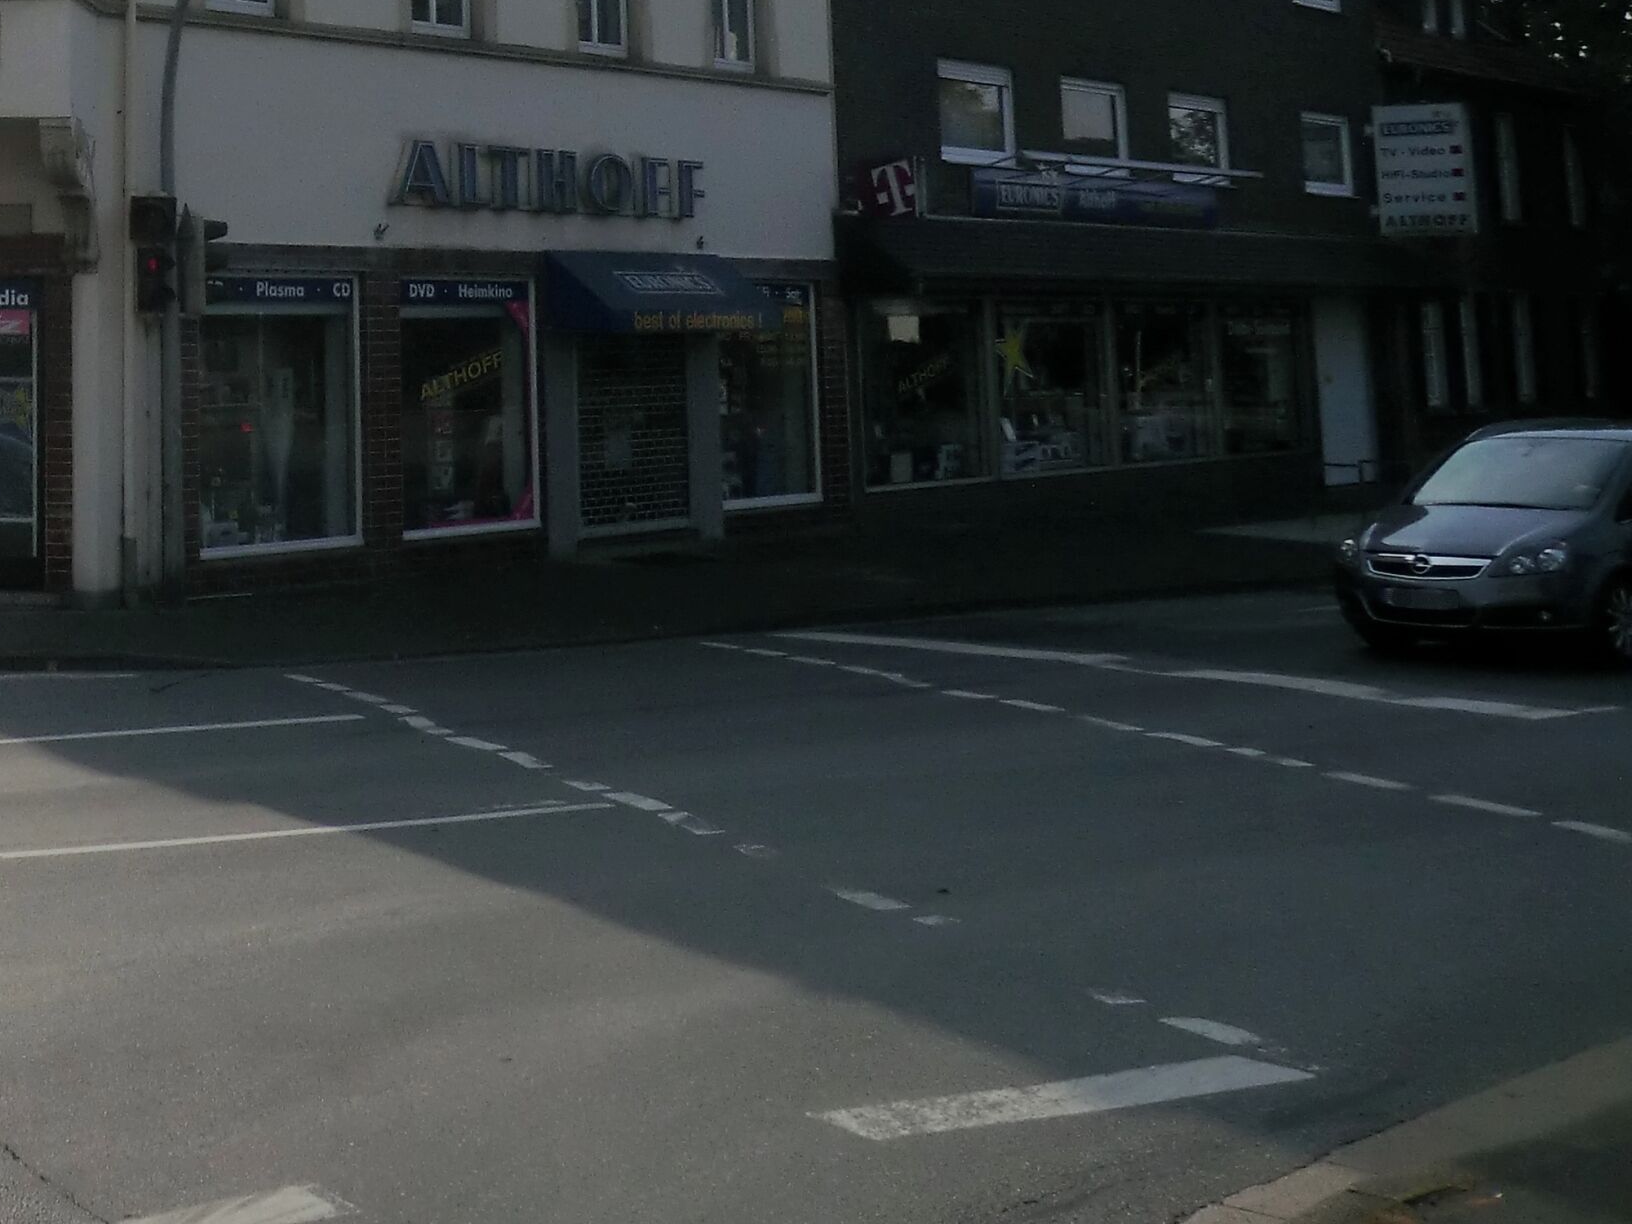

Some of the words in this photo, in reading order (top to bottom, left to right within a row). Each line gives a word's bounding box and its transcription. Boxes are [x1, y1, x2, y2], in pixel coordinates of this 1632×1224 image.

[388, 138, 706, 220] ALTHOFF
[998, 185, 1060, 209] EURONICS
[255, 280, 305, 298] Plasma
[332, 282, 351, 298] CD
[408, 283, 435, 298] DVD
[457, 283, 514, 299] Heimkino
[633, 311, 664, 330] best
[668, 311, 681, 330] of
[685, 311, 754, 330] electronics
[420, 350, 505, 402] ALTHOFF
